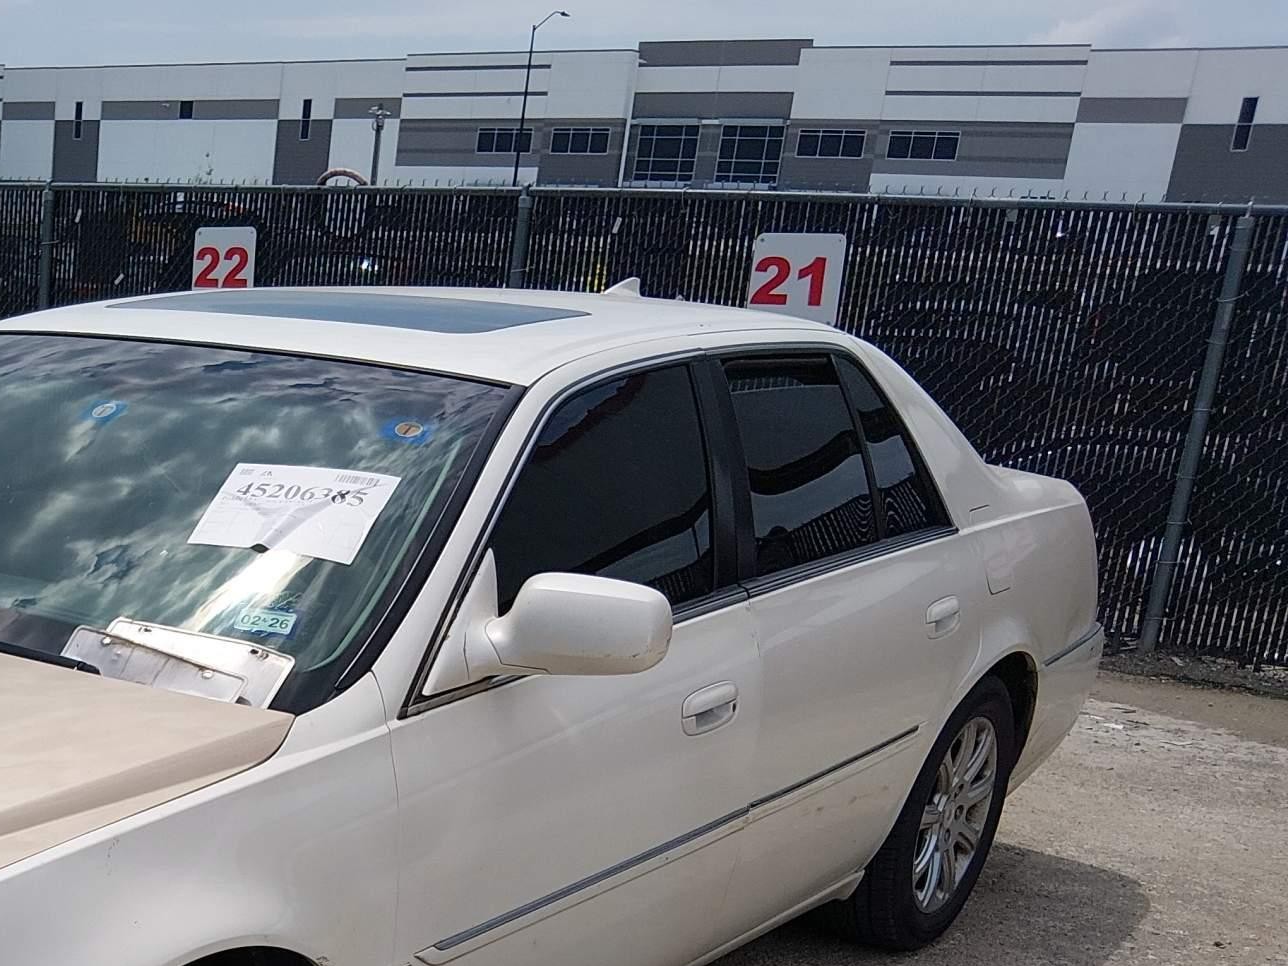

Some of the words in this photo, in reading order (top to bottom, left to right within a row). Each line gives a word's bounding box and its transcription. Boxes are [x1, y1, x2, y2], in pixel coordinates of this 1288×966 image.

[194, 246, 249, 288] 22
[749, 256, 827, 306] 21
[237, 482, 369, 507] 45206385
